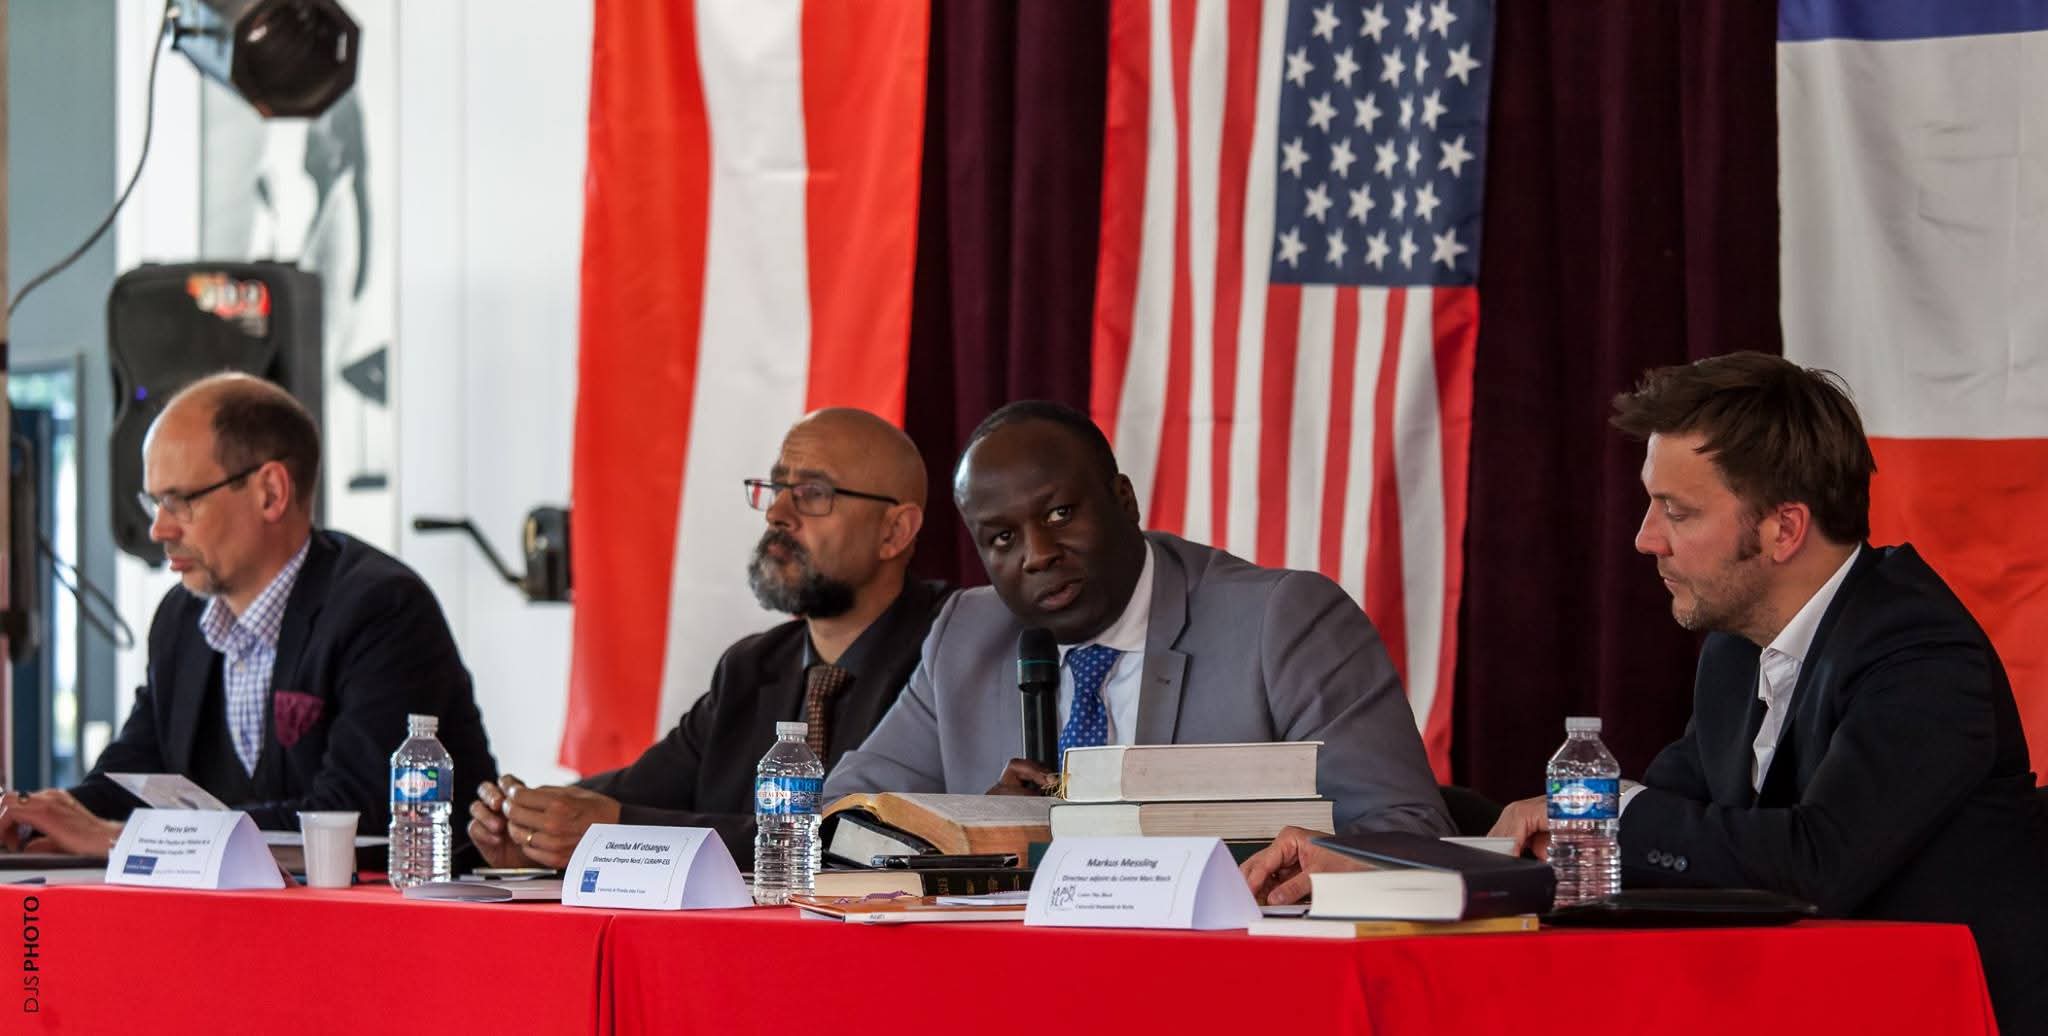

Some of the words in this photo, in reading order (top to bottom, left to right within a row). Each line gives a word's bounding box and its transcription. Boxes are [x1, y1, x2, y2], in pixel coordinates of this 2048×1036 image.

[605, 841, 632, 850] Okemba
[592, 855, 612, 863] Directeur
[1087, 858, 1119, 867] Markus
[1120, 858, 1158, 869] Messling
[1062, 874, 1088, 882] Directeur
[1119, 874, 1138, 882] Centre
